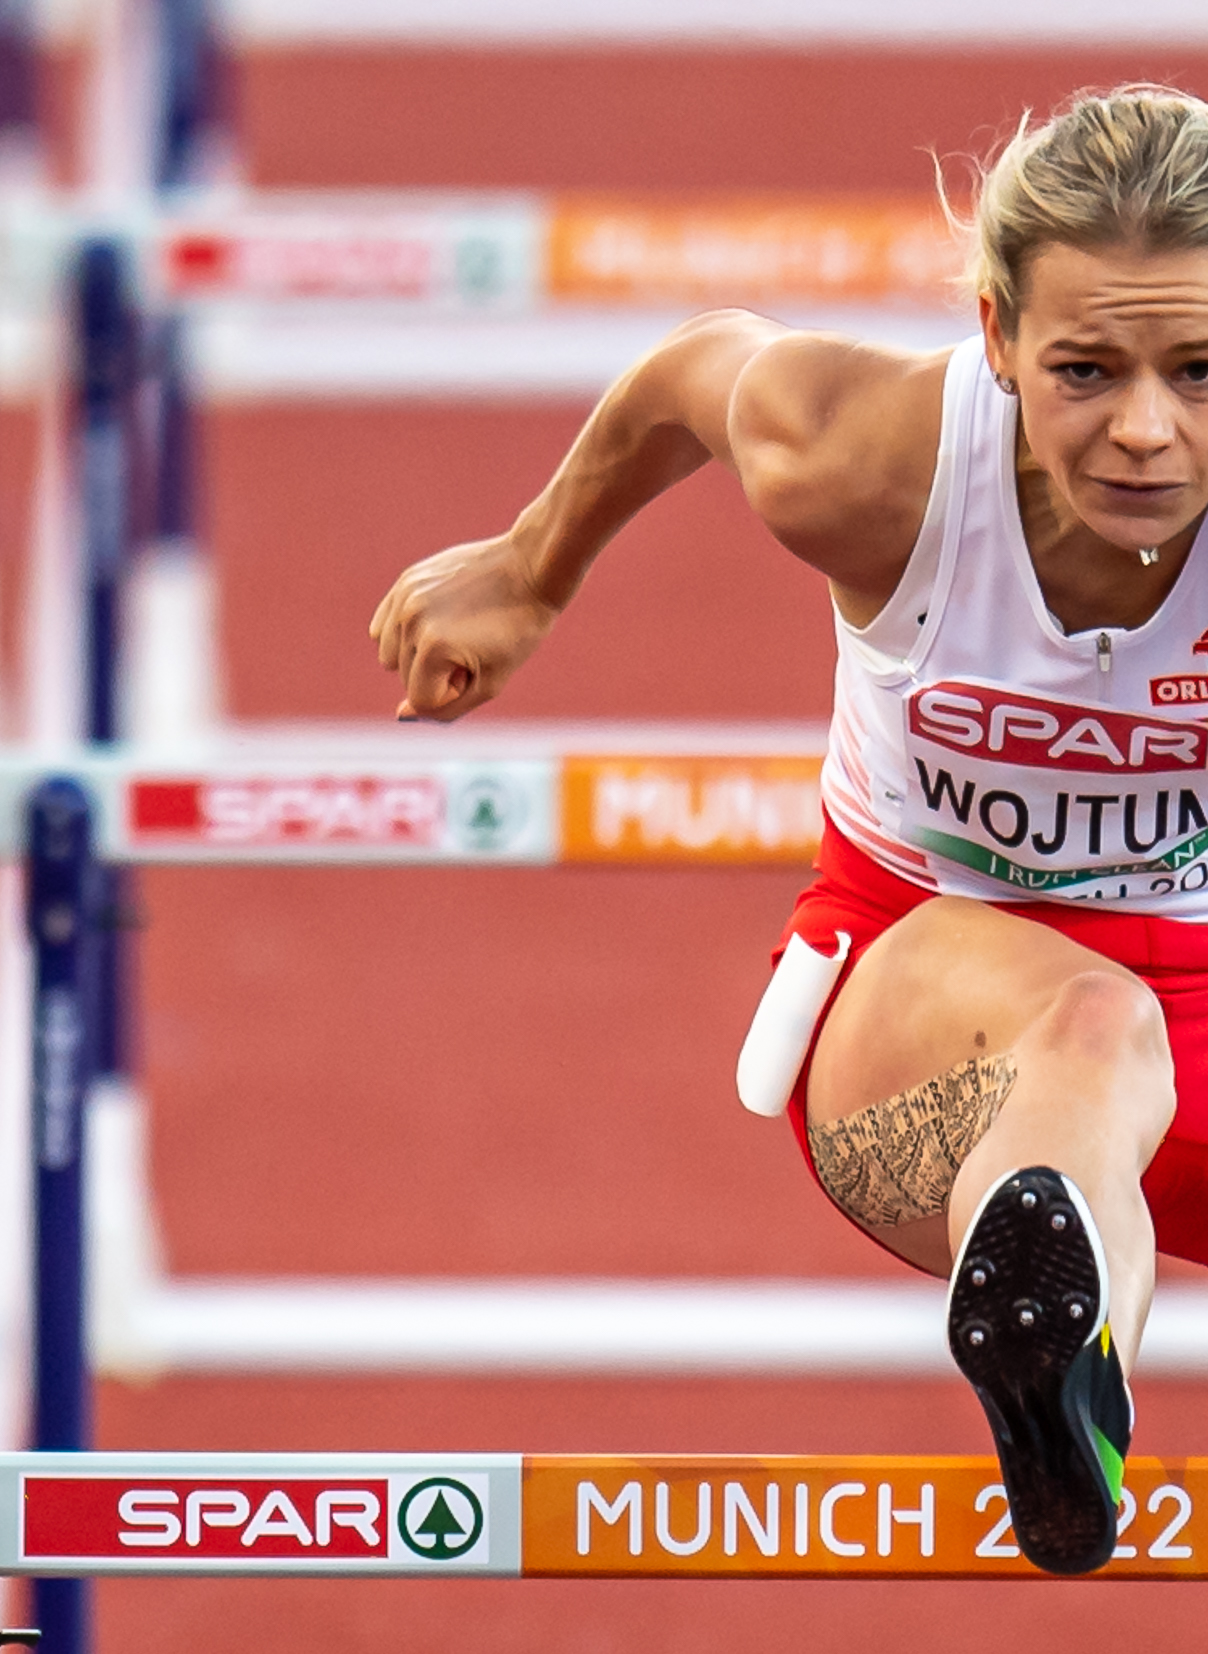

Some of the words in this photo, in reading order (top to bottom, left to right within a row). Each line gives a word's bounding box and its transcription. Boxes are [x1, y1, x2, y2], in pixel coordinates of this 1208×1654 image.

[917, 690, 1201, 766] SPAR
[117, 1489, 381, 1547] SPAR
[576, 1481, 935, 1558] MUNICH
[973, 1483, 1193, 1559] 222
